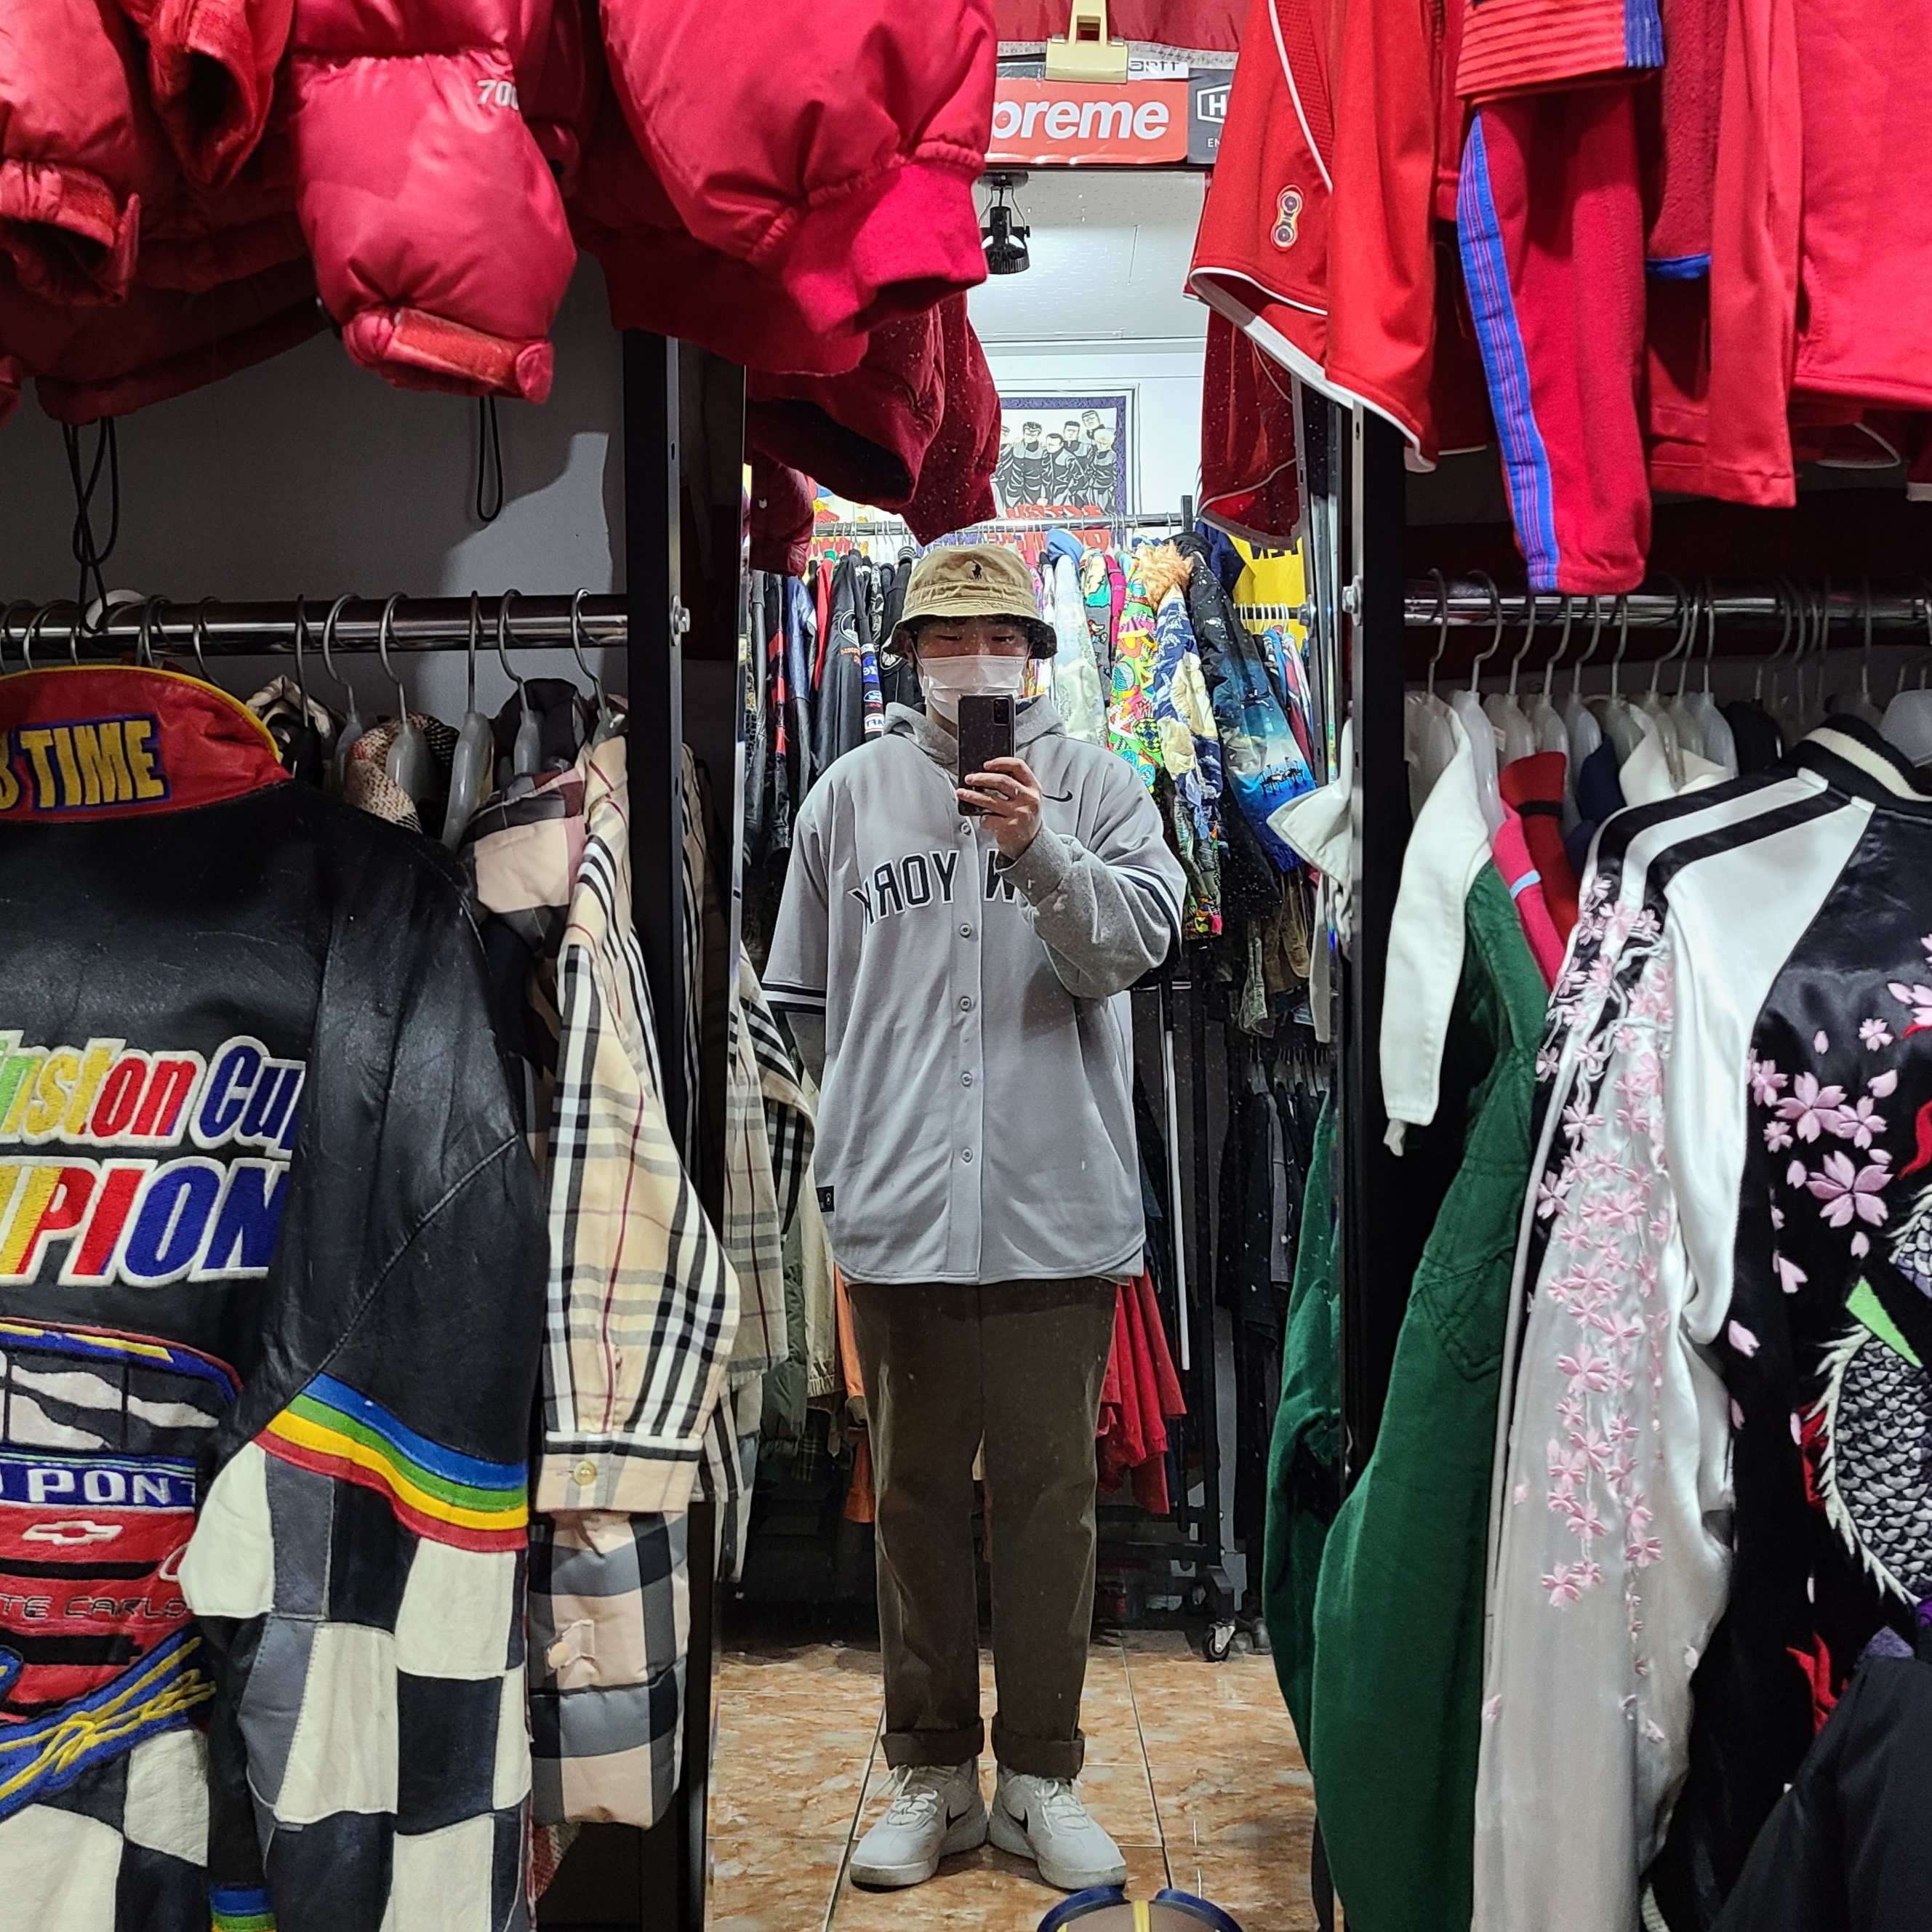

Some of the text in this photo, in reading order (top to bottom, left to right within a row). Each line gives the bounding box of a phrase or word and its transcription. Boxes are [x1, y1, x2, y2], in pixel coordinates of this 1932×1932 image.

[992, 100, 1169, 140] preme
[0, 1030, 305, 1160] nston Cu
[0, 1155, 291, 1287] PION
[64, 1595, 189, 1619] CARLO
